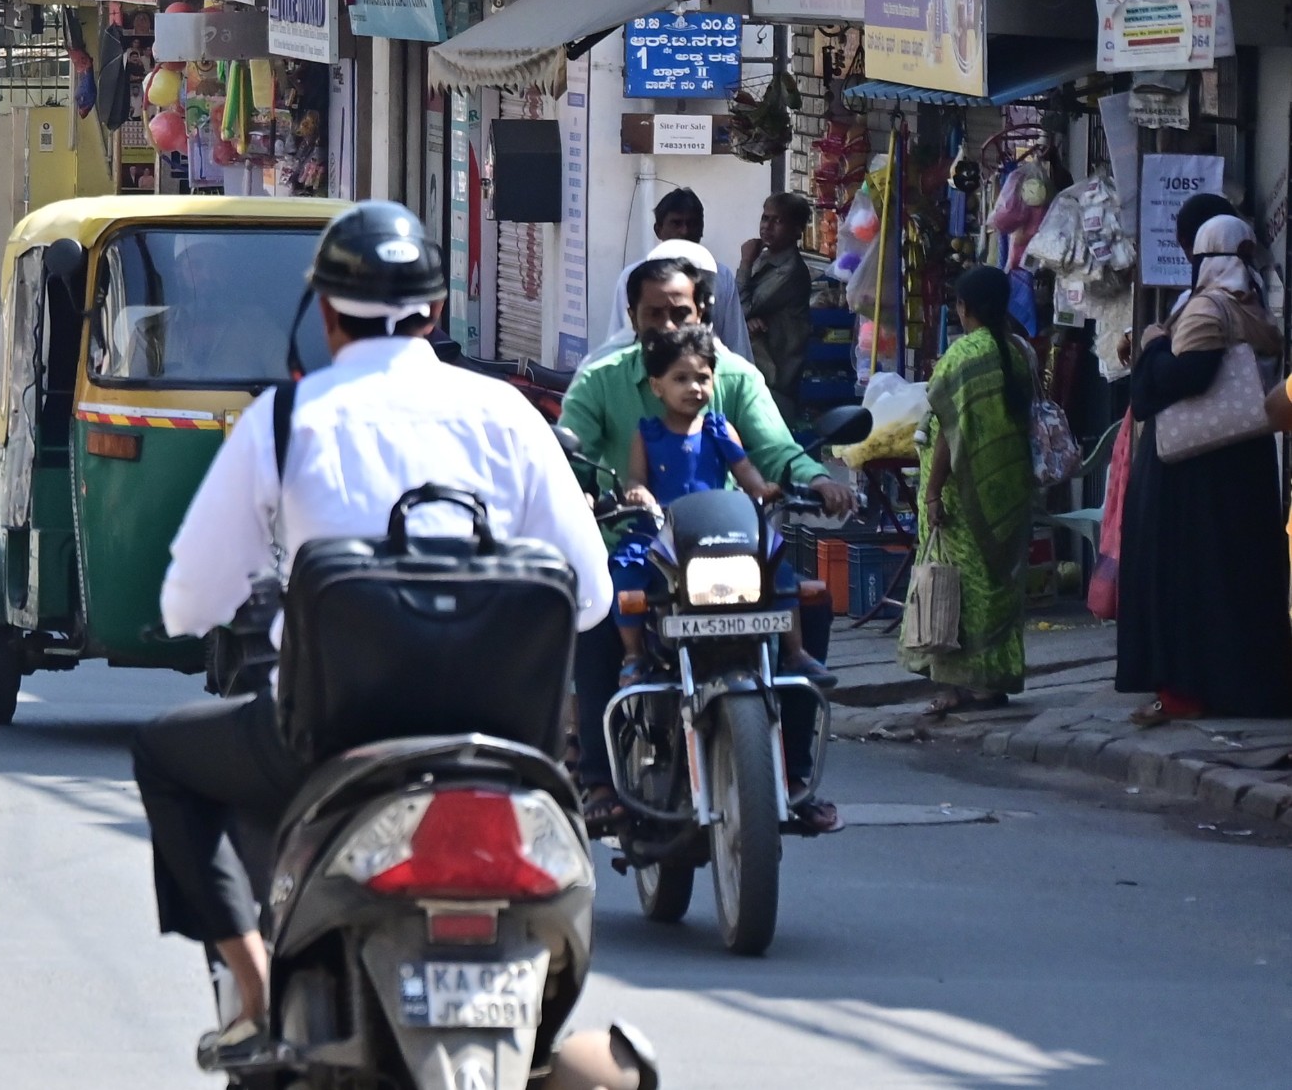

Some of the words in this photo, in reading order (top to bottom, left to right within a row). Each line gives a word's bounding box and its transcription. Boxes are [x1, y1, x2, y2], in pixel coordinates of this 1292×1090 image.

[637, 46, 648, 70] 1
[701, 80, 714, 90] 46
[690, 123, 706, 131] Sale
[752, 615, 790, 631] 0025
